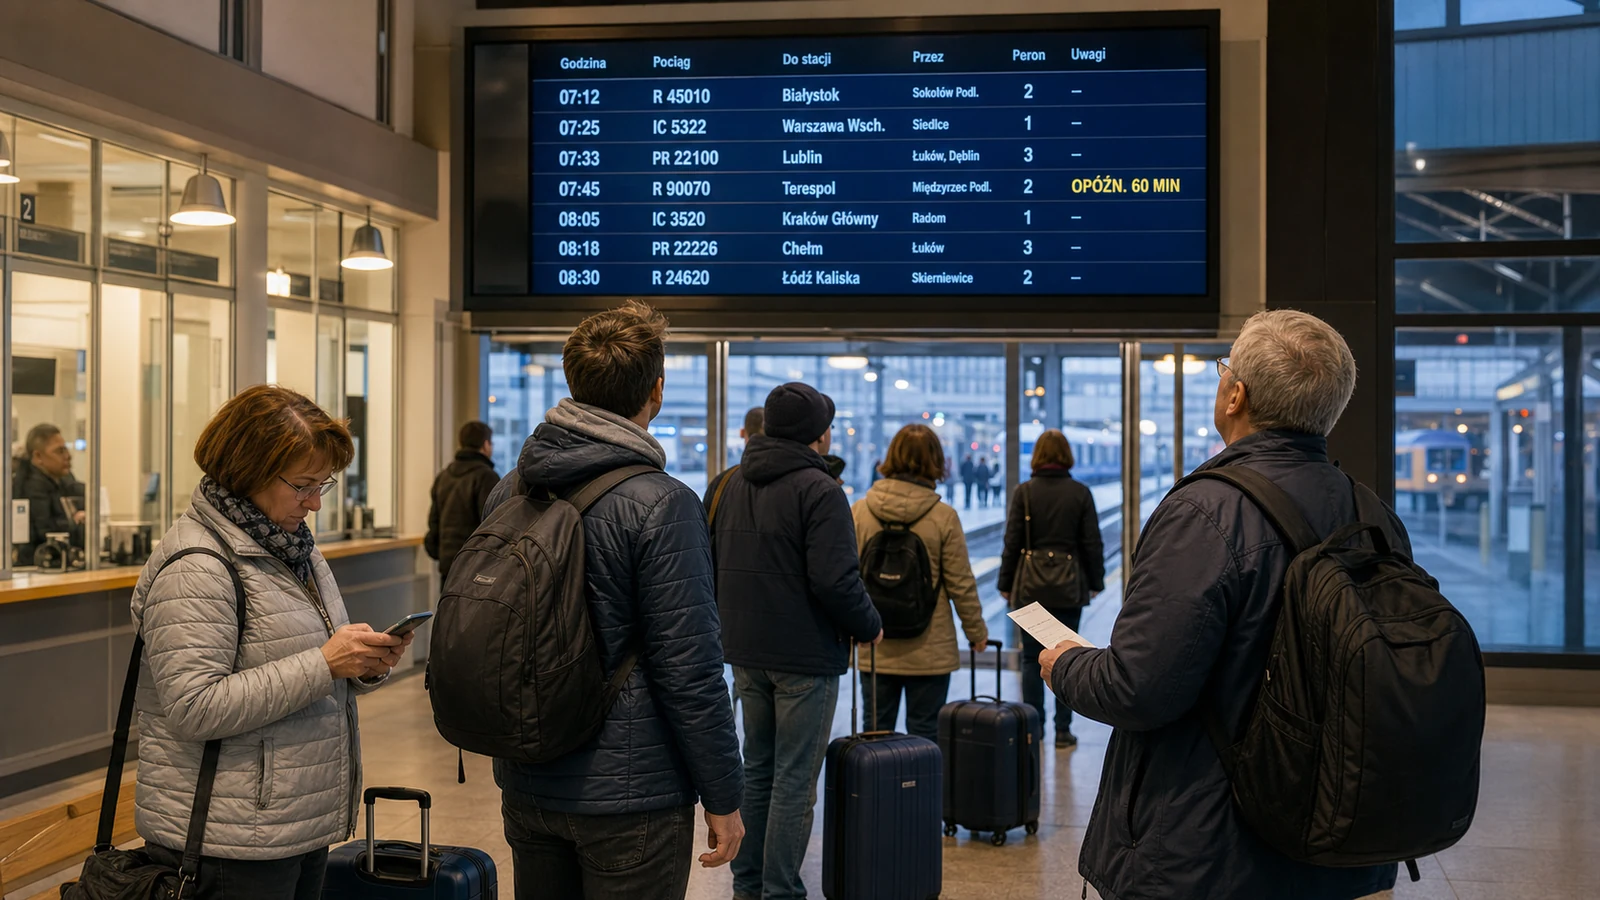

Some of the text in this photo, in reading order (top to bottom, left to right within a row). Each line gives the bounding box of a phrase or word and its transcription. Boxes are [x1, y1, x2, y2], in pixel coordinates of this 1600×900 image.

[560, 47, 1106, 70] Godzina Pociąg Do stacji Przez Peron Uwagi
[559, 89, 600, 104] 07:12
[653, 89, 663, 104] R
[666, 88, 711, 104] 45010
[782, 87, 840, 105] Białystok
[955, 86, 980, 98] Podl.
[1023, 84, 1034, 99] 2
[559, 120, 600, 136] 07:25
[653, 119, 667, 135] IC
[670, 119, 707, 135] 5322
[782, 118, 845, 133] Warszawa
[847, 117, 886, 132] Wsch.
[912, 118, 950, 130] Siedlce
[1024, 115, 1032, 131] 1
[558, 150, 600, 166] 07:33
[652, 150, 671, 166] PR
[673, 149, 719, 166] 22100
[782, 149, 823, 164] Lublin
[912, 149, 947, 163] Łuków,
[948, 149, 980, 164] Dęblin
[1023, 147, 1034, 162] 3
[558, 175, 1180, 198] 07:45 R 90070 Terespol Międzyrzec Podl. 2 OPÓŹN. 60 MIN
[23, 198, 32, 220] 2
[558, 211, 600, 227] 08:05
[652, 211, 667, 227] IC
[669, 211, 706, 227] 3520
[782, 210, 828, 226] Kraków
[831, 210, 879, 229] Główny
[912, 212, 947, 224] Radom
[1023, 209, 1031, 225] 1
[558, 240, 600, 256] 08:18
[652, 241, 671, 256] PR
[673, 240, 718, 256] 22226
[782, 240, 824, 255] Chełm
[911, 241, 945, 254] Łuków
[1022, 239, 1033, 255] 3
[558, 270, 600, 286] 08:30
[652, 270, 662, 286] R
[665, 270, 710, 286] 24620
[781, 270, 813, 285] Łódź
[816, 270, 861, 285] Kaliska
[911, 271, 974, 284] Skierniewice
[1022, 269, 1033, 285] 2
